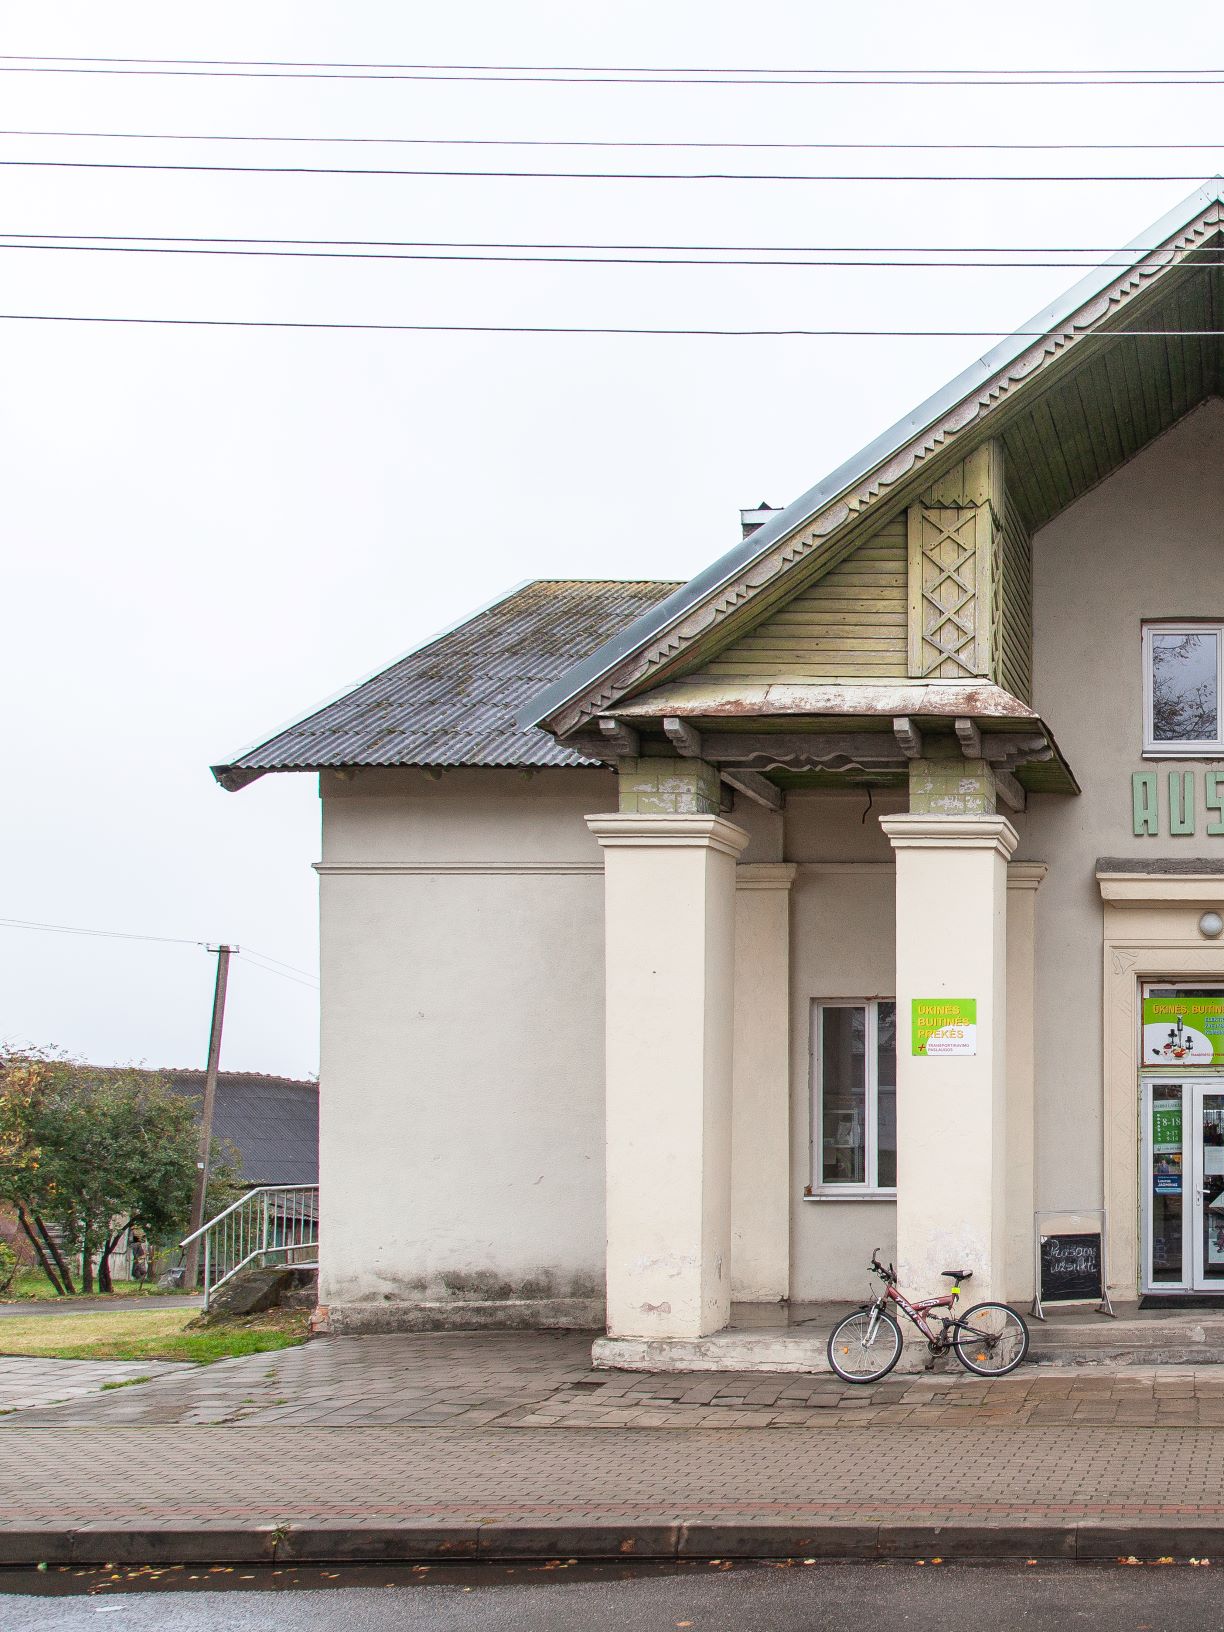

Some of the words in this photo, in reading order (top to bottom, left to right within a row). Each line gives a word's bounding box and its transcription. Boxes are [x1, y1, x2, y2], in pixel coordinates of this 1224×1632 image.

[918, 1016, 970, 1027] BUITINĖS
[918, 1028, 964, 1039] PREKĖS
[1162, 1118, 1181, 1126] 8-18
